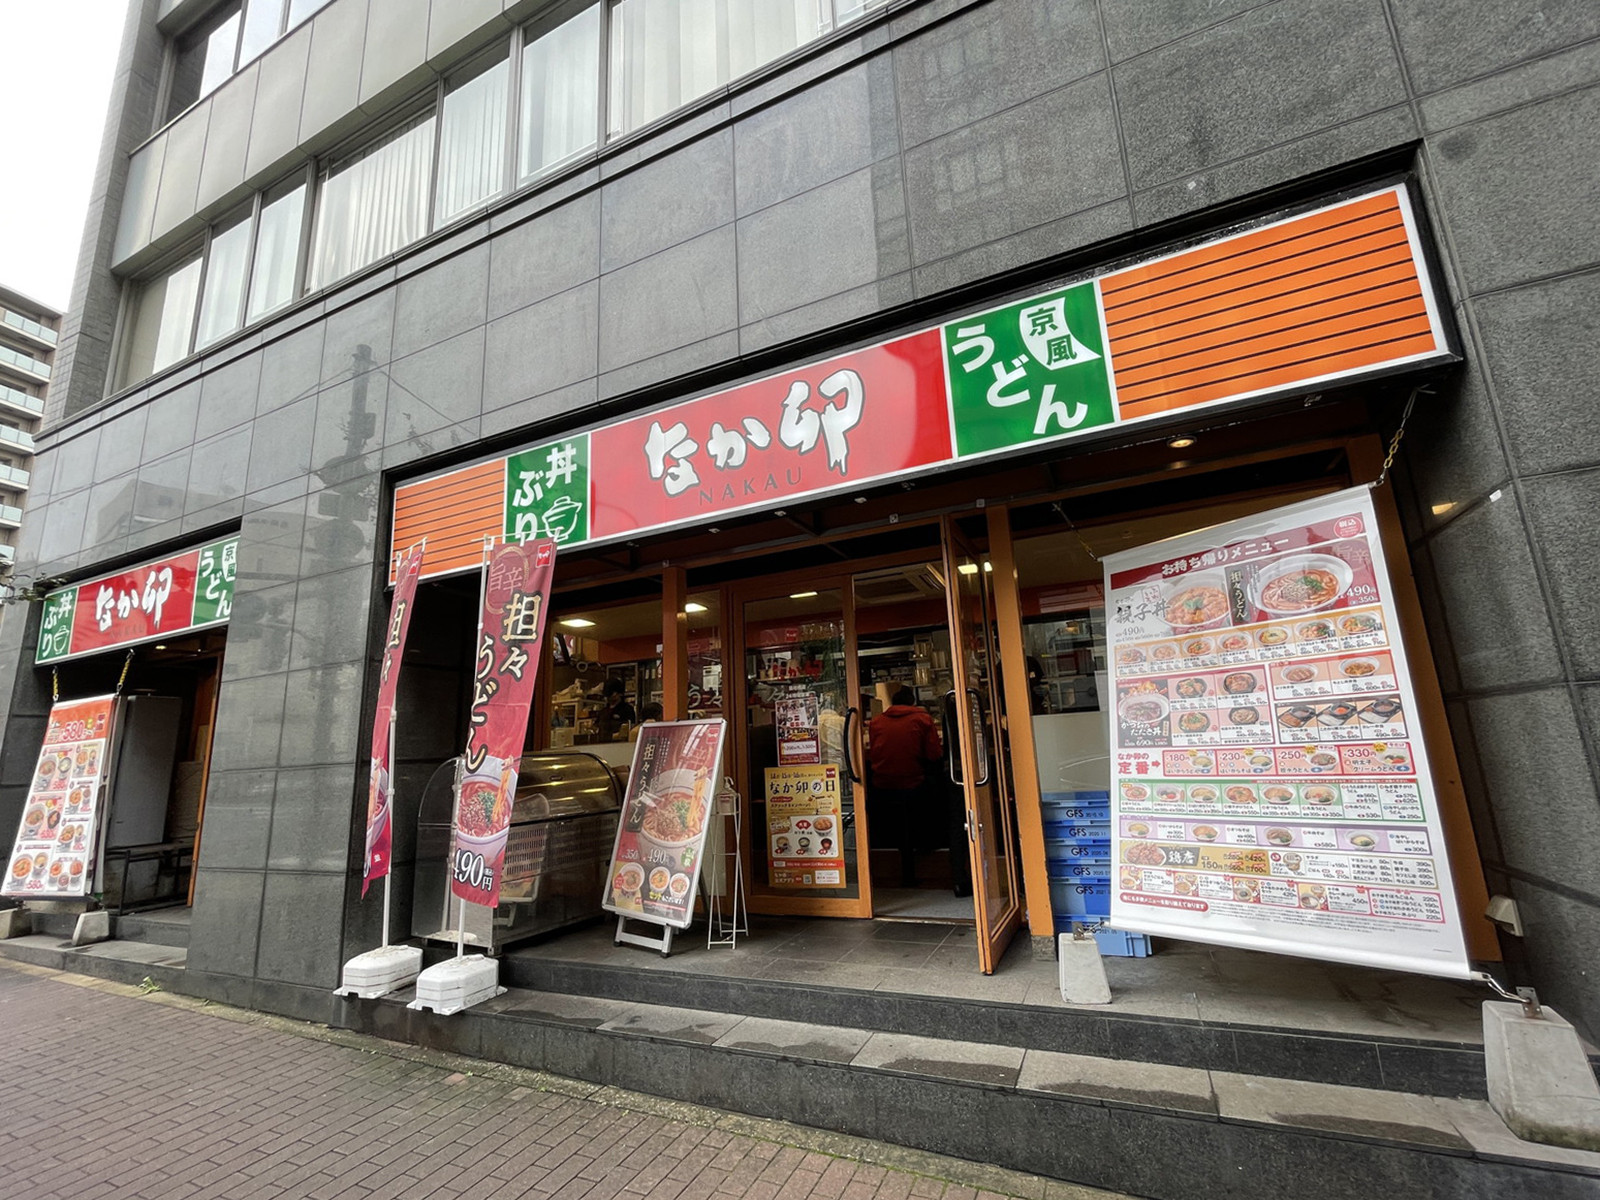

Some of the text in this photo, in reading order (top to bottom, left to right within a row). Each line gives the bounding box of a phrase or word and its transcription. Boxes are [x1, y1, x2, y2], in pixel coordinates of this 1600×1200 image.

[1027, 307, 1078, 366] 京風
[952, 323, 1089, 435] うどん
[643, 367, 865, 497] なか卯
[512, 443, 578, 541] 丼ぶり
[699, 466, 803, 506] NAKAU
[1161, 538, 1290, 576] お持ち帰りメニュー
[95, 567, 173, 633] なか卯
[201, 550, 232, 618] うどん
[1229, 571, 1248, 619] 担々うどん
[42, 592, 74, 658] 丼ぶり
[1115, 598, 1171, 624] 親子丼
[464, 593, 542, 774] 担々 うどん
[769, 780, 835, 795] なか卯の日
[1117, 761, 1149, 775] 定番
[1066, 809, 1084, 818] GFS
[1069, 828, 1087, 837] GFS
[1071, 847, 1089, 856] GFS
[1073, 867, 1091, 876] GFS
[1076, 886, 1094, 895] GFS
